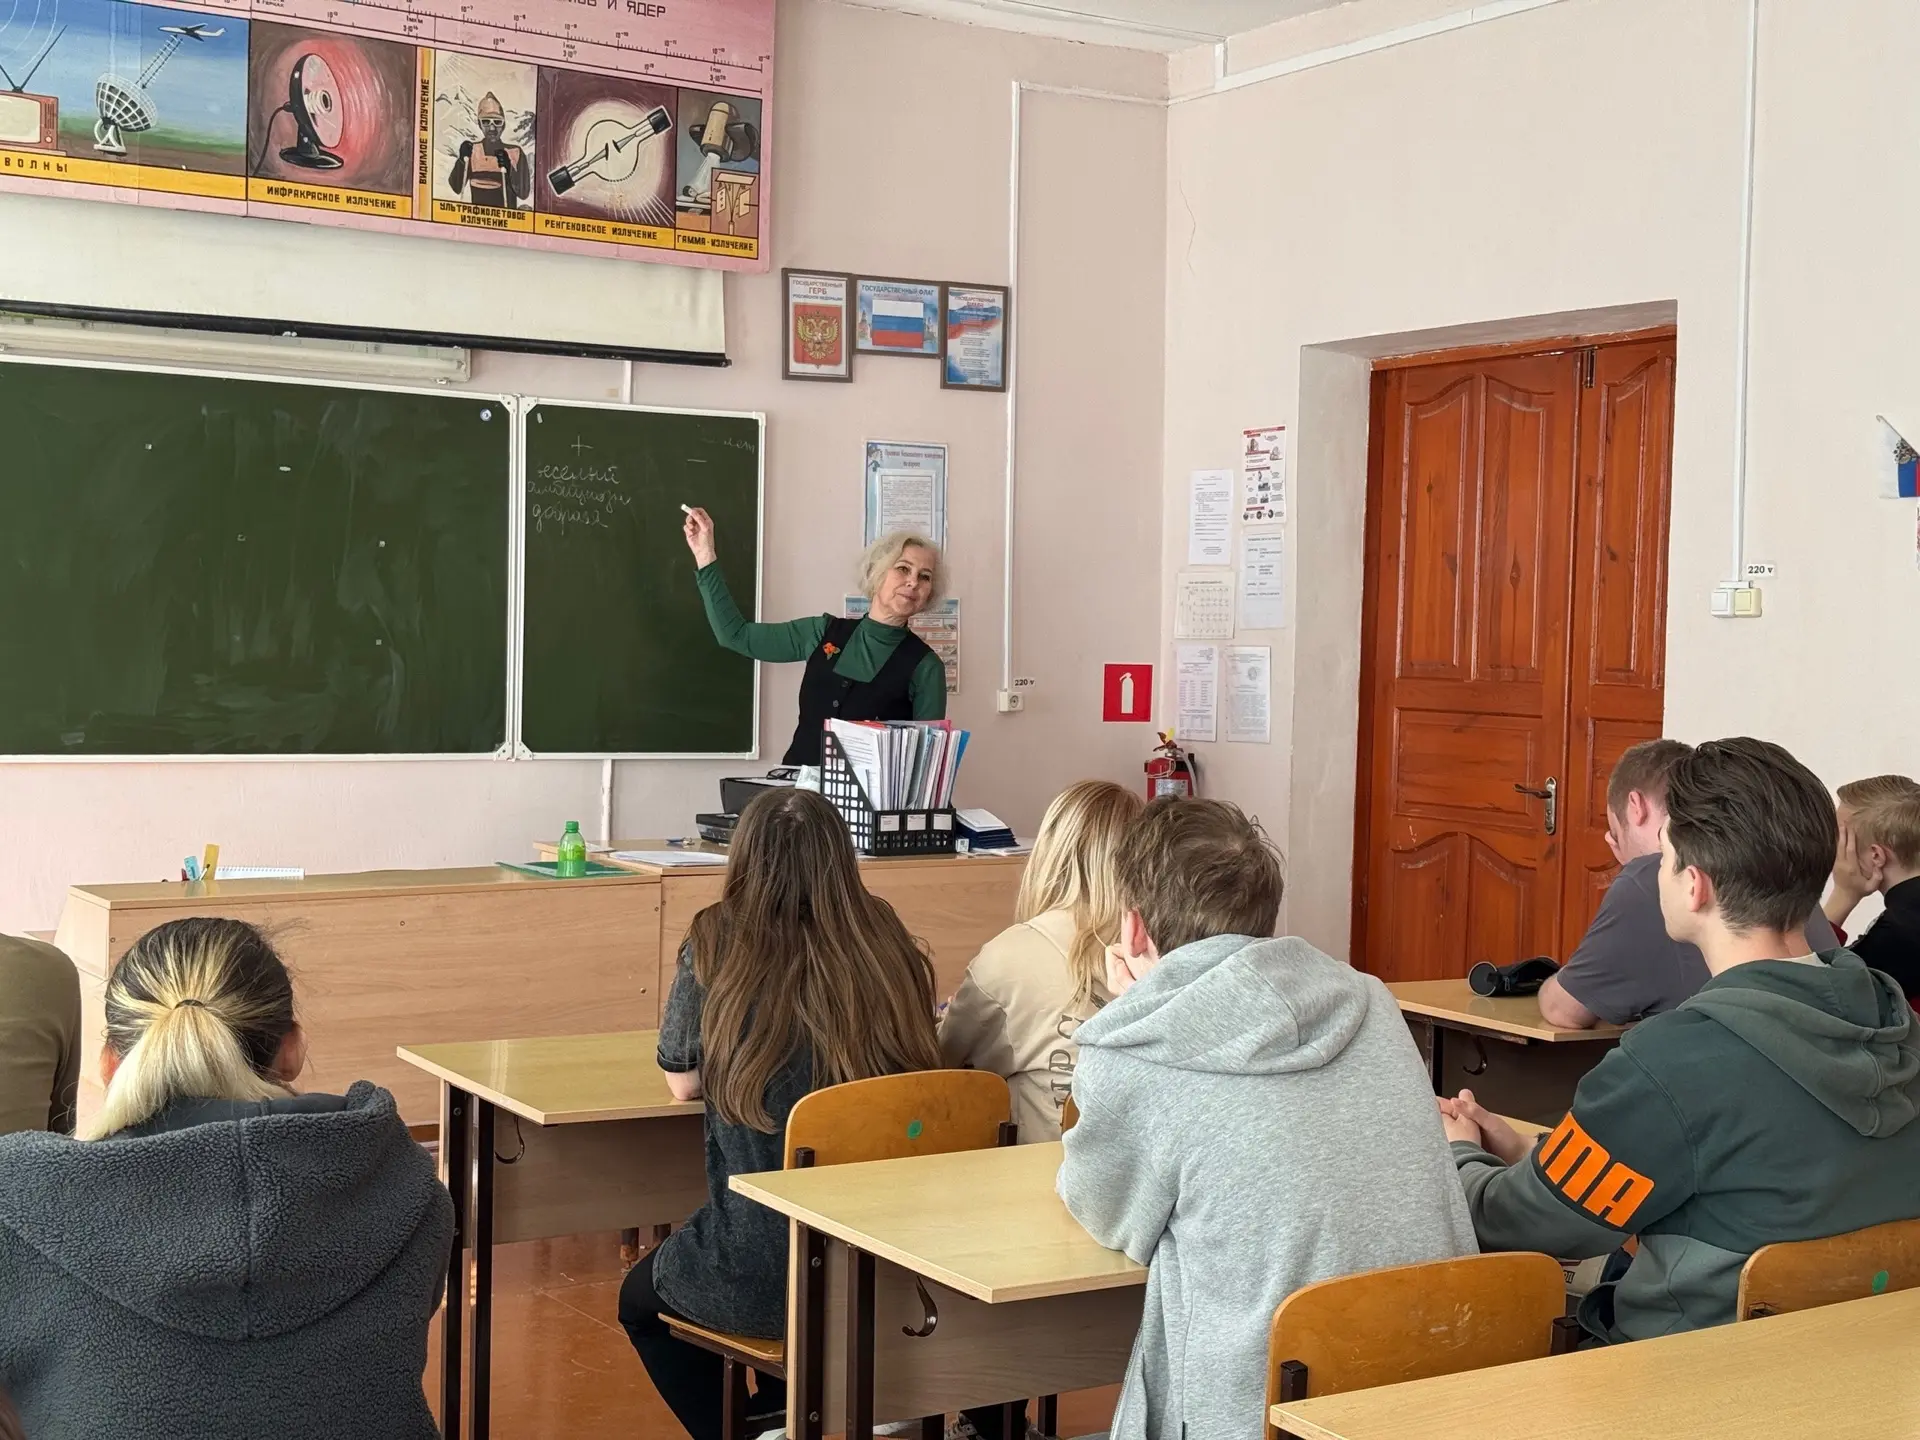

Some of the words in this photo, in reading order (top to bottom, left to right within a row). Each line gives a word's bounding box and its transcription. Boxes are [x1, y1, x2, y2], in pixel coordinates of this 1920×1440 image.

[626, 0, 666, 17] ЯДЕР
[419, 78, 430, 132] ИЗЛУЧЕНИЕ
[4, 157, 68, 173] ВОЛНЫ
[418, 137, 429, 185] ВИДИМОЕ
[266, 185, 341, 204] ИНФРАКРАСНОЕ
[345, 195, 397, 210] ИЗЛУЧЕНИЕ
[439, 202, 526, 220] УЛЬТРАФИОЛЕТОВОЕ
[460, 214, 508, 228] ИЗЛУЧЕНИЕ
[611, 226, 658, 240] ИЗЛУЧЕНИЕ
[808, 286, 828, 295] ГЕРБ
[861, 284, 917, 295] ГОСУДАРСТВЕННЫЙ
[918, 288, 934, 297] ФЛАГ
[1747, 565, 1766, 575] 220
[1014, 678, 1029, 687] 220
